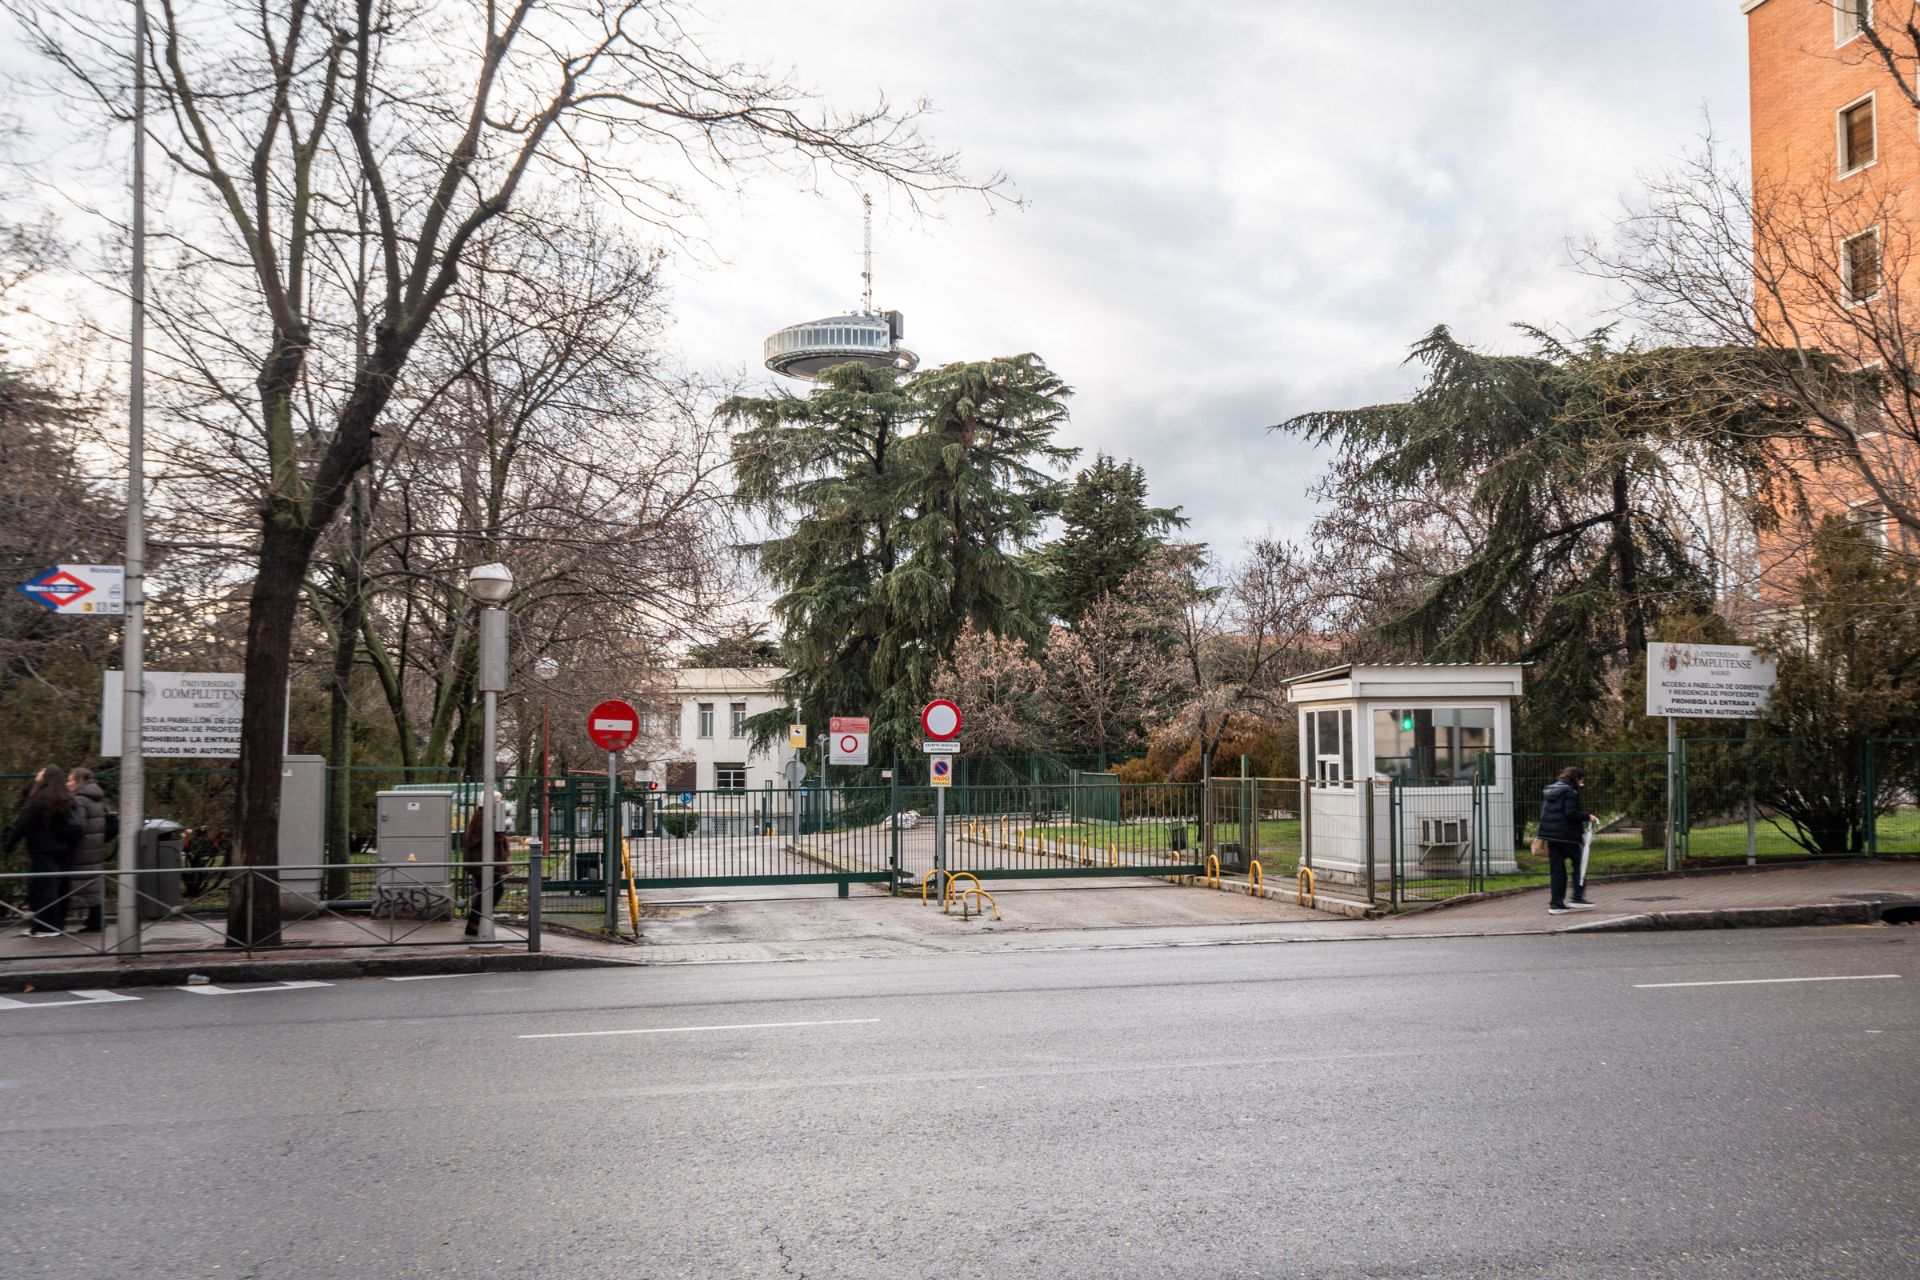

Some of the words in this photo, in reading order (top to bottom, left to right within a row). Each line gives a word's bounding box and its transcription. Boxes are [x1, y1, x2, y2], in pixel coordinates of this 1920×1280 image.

[1688, 658, 1752, 669] COMPLUTENSE
[180, 680, 237, 688] UNIVERSIDAD
[161, 688, 245, 700] COMPLUTENS
[1720, 690, 1760, 698] PROFESORES
